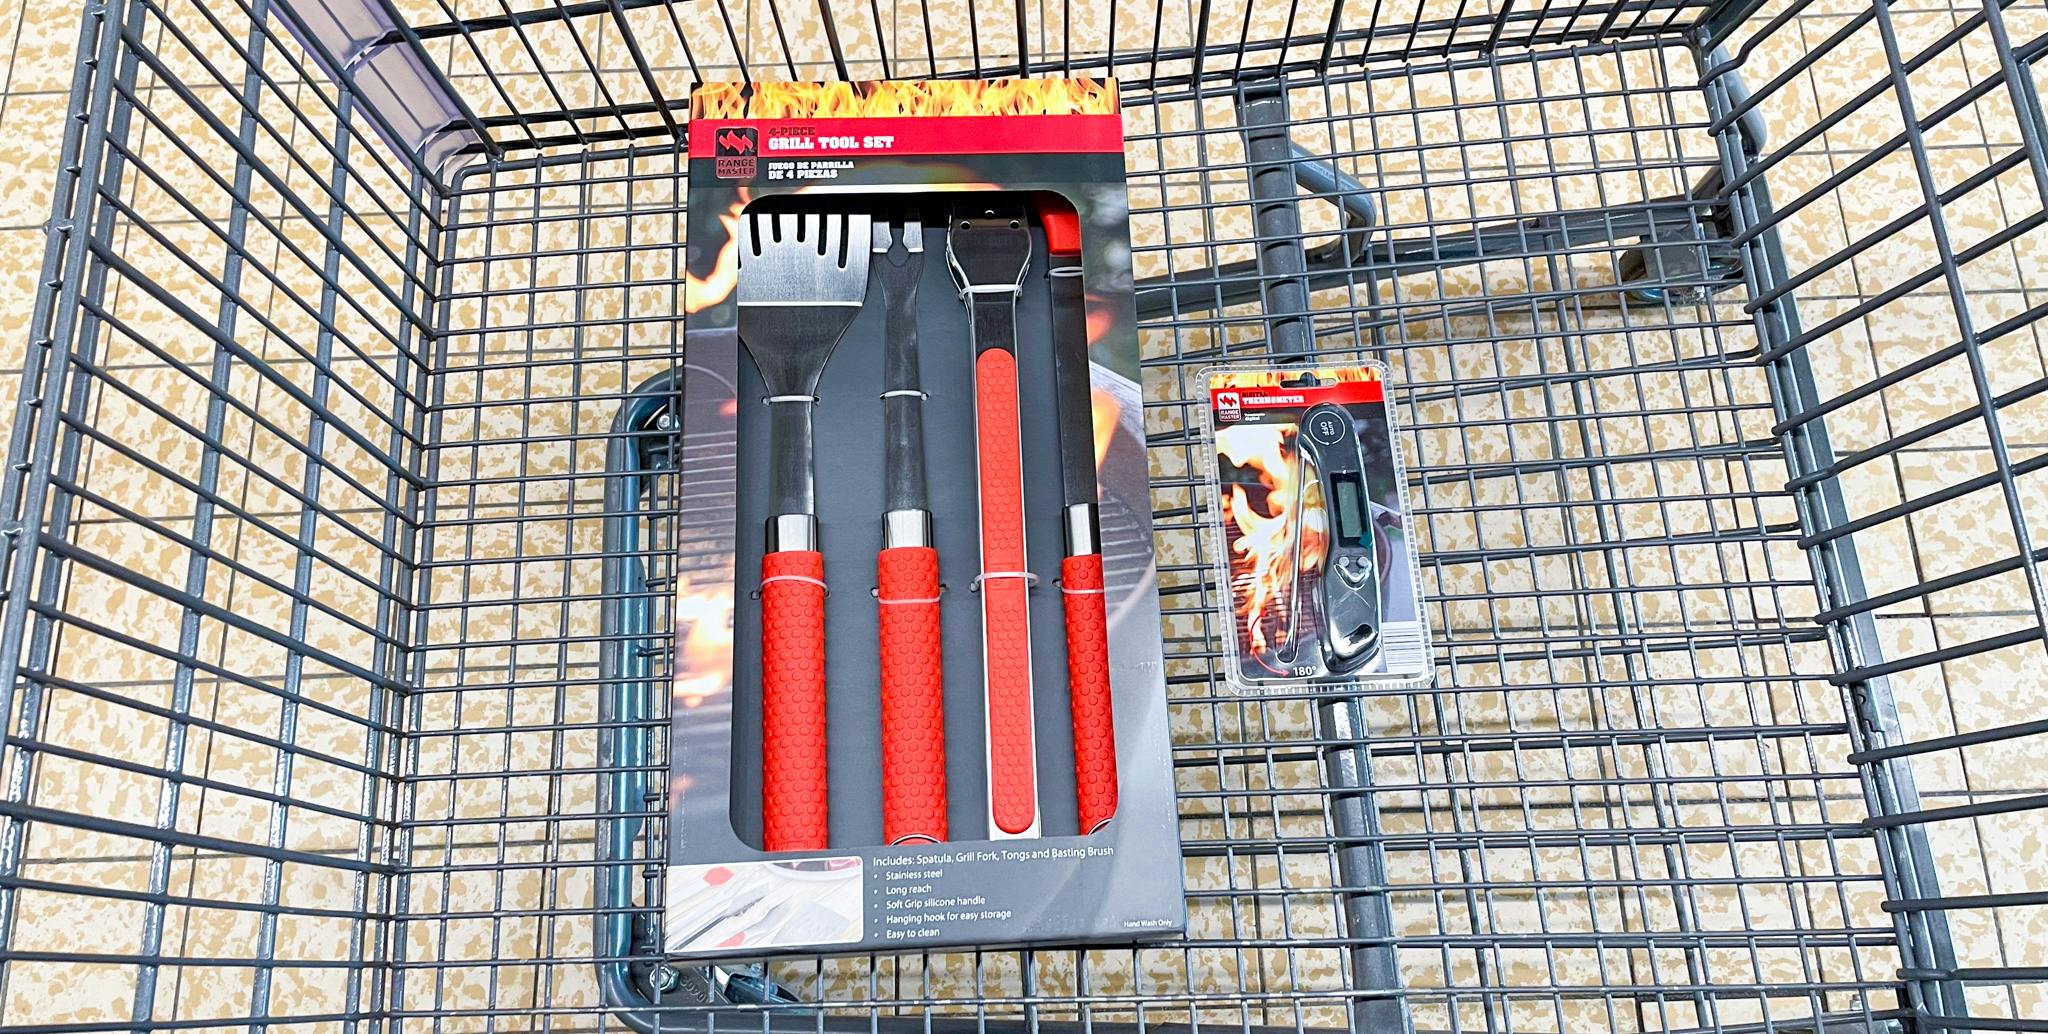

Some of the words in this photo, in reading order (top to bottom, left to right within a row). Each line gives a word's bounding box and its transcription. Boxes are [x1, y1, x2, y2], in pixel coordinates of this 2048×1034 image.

[768, 127, 815, 136] 4-PIECE
[768, 137, 814, 150] GRILL
[818, 136, 859, 149] TOOL
[863, 135, 895, 149] SET
[717, 158, 755, 167] RANGE
[768, 162, 795, 170] JUEGO
[811, 161, 854, 169] PARRILLA
[717, 167, 756, 176] MASTER
[768, 170, 784, 179] DE
[786, 170, 795, 179] 4
[797, 169, 838, 179] PIEZAS
[1242, 395, 1304, 405] THERMOMETER
[1320, 421, 1330, 436] OFF
[1293, 665, 1317, 676] 180°
[873, 856, 915, 866] Includes:
[916, 853, 954, 866] Spatula,
[956, 851, 975, 862] Grill
[977, 851, 1000, 862] Fork,
[1001, 850, 1030, 862] Tongs
[1032, 848, 1050, 858] and
[1051, 847, 1086, 860] Basting
[1087, 846, 1114, 856] Brush
[886, 870, 922, 880] Stainless
[923, 869, 943, 879] steel
[886, 886, 907, 896] Long
[909, 884, 932, 894] reach
[886, 899, 903, 910] Soft
[904, 899, 923, 910] Grip
[924, 897, 955, 907] silicone
[957, 896, 986, 905] handle
[886, 914, 922, 926] Hanging
[924, 912, 945, 922] hook
[947, 911, 959, 921] for
[960, 912, 979, 921] easy
[980, 909, 1011, 919] storage
[1123, 920, 1140, 928] Hand
[1141, 919, 1158, 927] Wash
[1158, 918, 1173, 927] Only
[886, 929, 905, 940] Easy
[907, 929, 916, 938] to
[918, 928, 940, 937] clean
